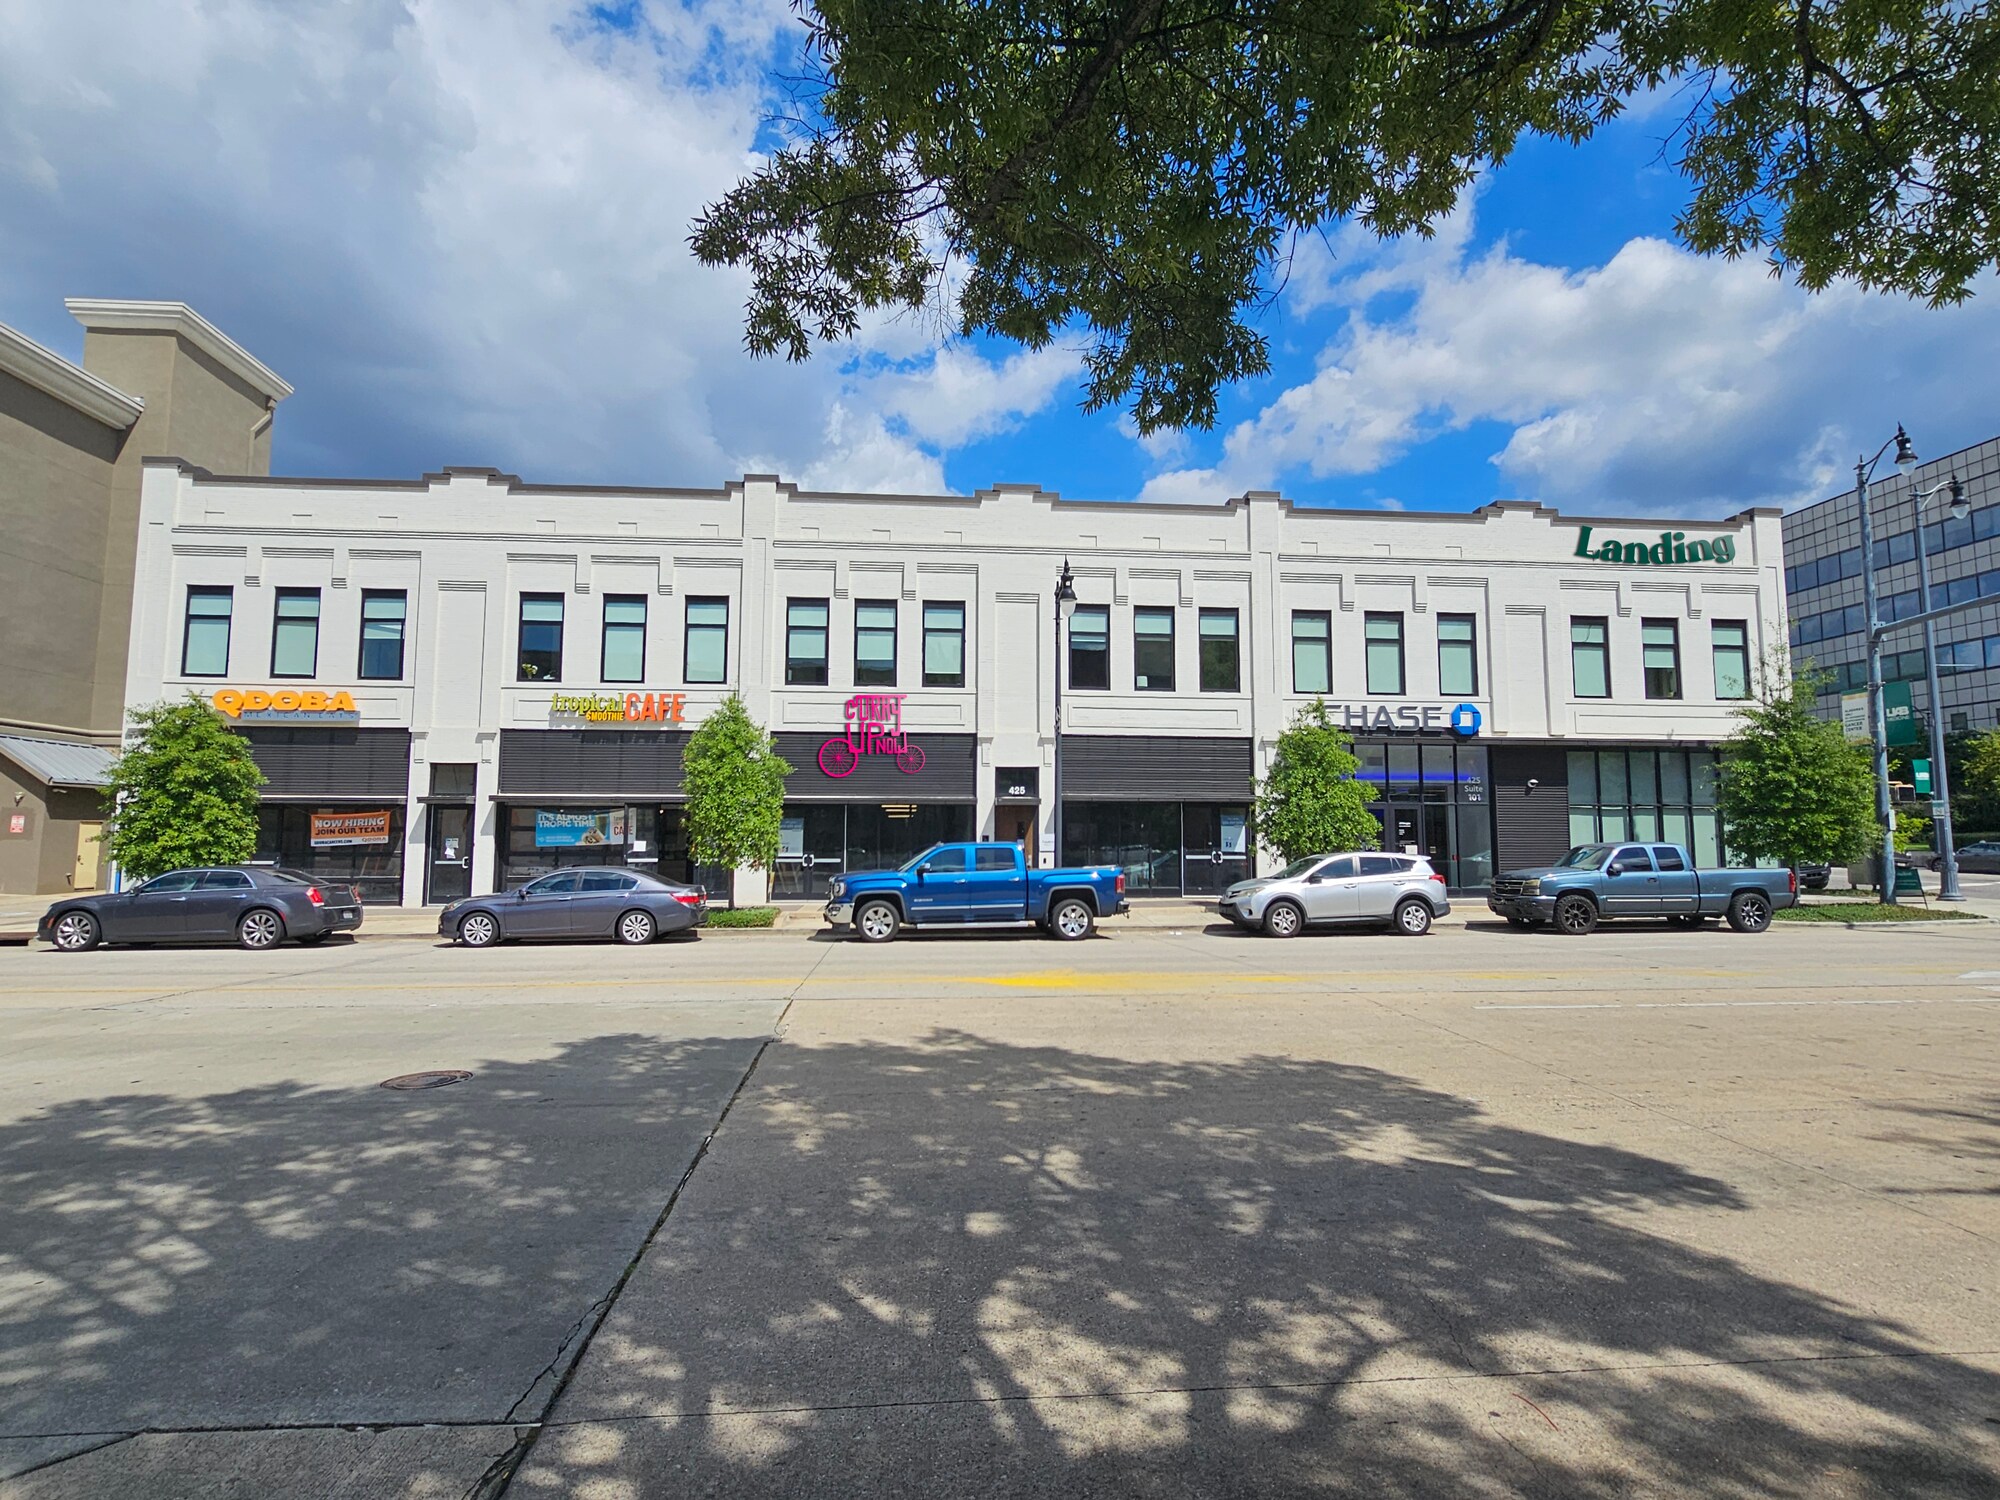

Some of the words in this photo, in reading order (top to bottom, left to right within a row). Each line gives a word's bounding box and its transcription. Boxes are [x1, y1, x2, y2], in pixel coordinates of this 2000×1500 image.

[1574, 525, 1736, 564] Landing
[212, 689, 356, 718] QDOBA
[552, 692, 625, 714] tropical
[625, 692, 686, 721] CAFE
[586, 710, 625, 721] SMOOTHIE
[845, 694, 907, 737] CURRY
[1886, 706, 1910, 717] UAB
[846, 721, 885, 755] UP
[876, 731, 908, 755] NOW
[1466, 776, 1481, 784] 425
[1008, 786, 1026, 795] 425
[315, 819, 343, 828] NOW
[345, 817, 385, 827] HIRING
[538, 820, 572, 828] TROPIC
[573, 819, 596, 827] TIME
[315, 828, 336, 836] JOIN
[337, 827, 357, 835] OUR
[359, 826, 385, 834] TEAM
